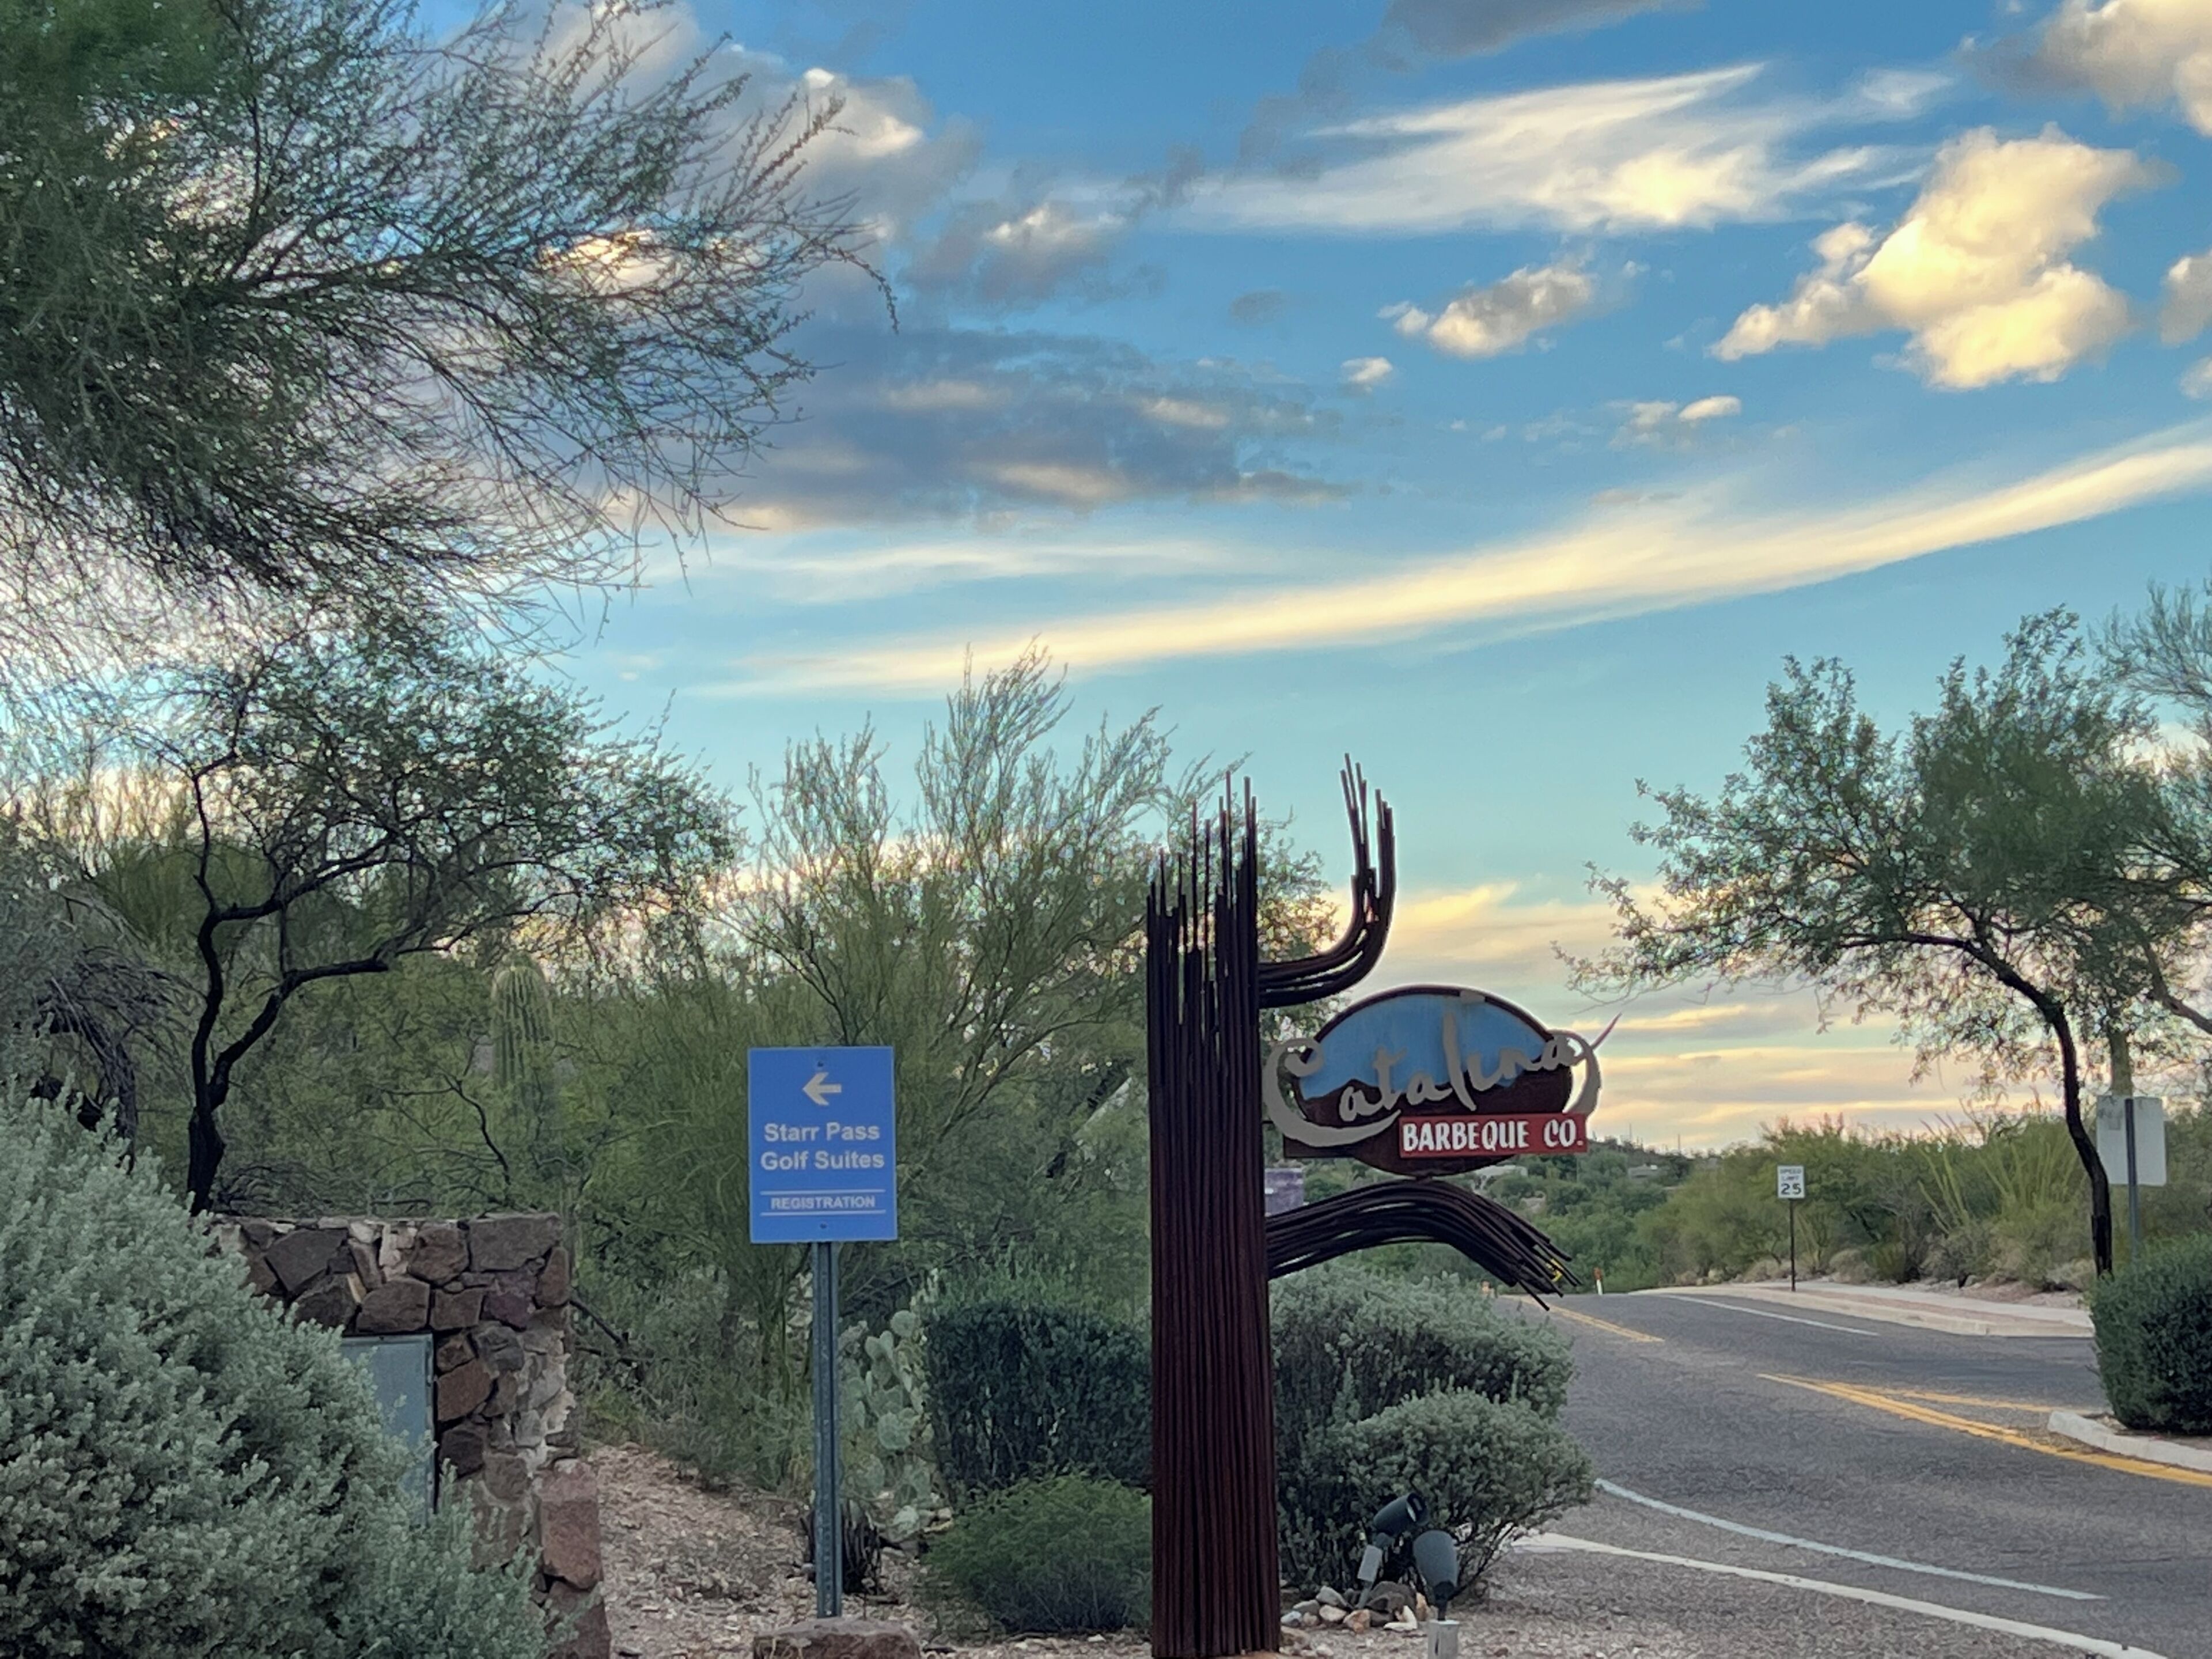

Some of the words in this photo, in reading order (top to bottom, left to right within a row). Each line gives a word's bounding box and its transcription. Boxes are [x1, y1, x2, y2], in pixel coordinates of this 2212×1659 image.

[1263, 1012, 1604, 1147] Catalina
[764, 1123, 820, 1142] Starr
[826, 1122, 880, 1141] Pass
[1402, 1120, 1529, 1152] BARBEQUE
[1543, 1119, 1584, 1147] CO.
[760, 1151, 809, 1171] Golf
[815, 1150, 885, 1170] Suites
[1781, 1183, 1802, 1195] 25
[770, 1195, 876, 1210] REGISTRATION
